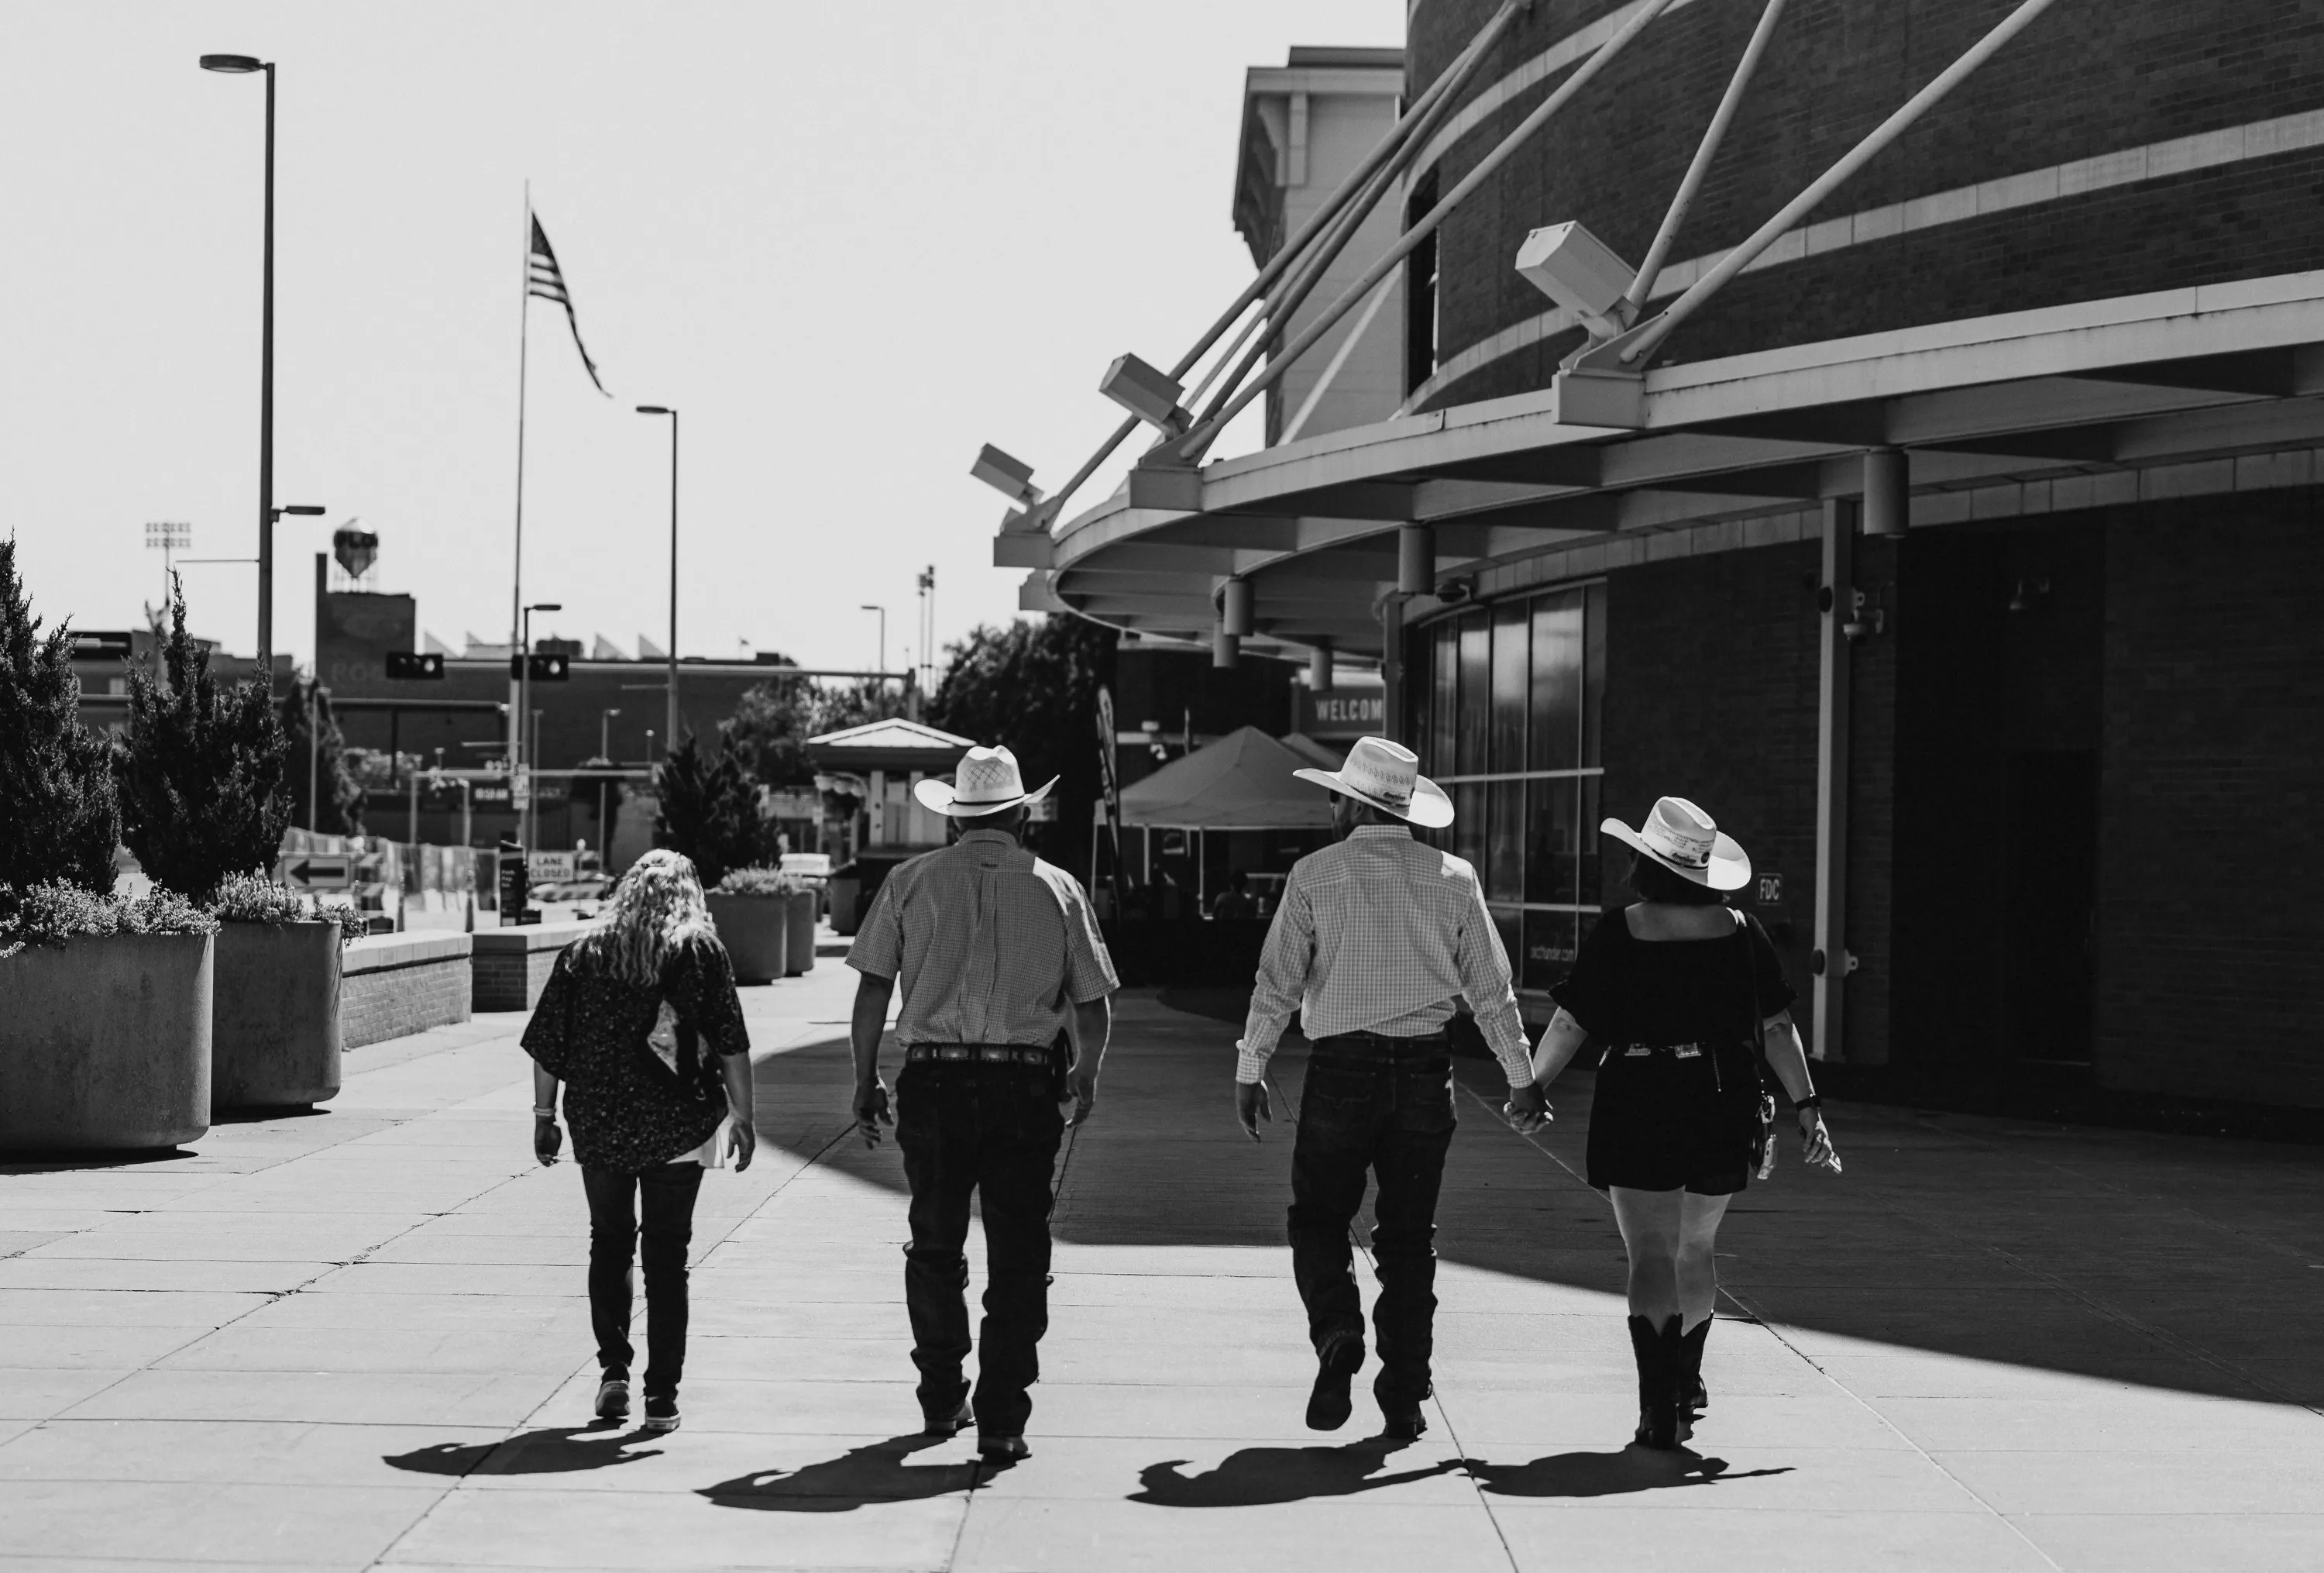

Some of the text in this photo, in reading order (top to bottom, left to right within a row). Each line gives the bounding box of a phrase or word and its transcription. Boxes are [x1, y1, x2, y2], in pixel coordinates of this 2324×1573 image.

[536, 857, 563, 866] LANE
[531, 868, 570, 878] CLOSED
[1759, 878, 1779, 900] FDC
